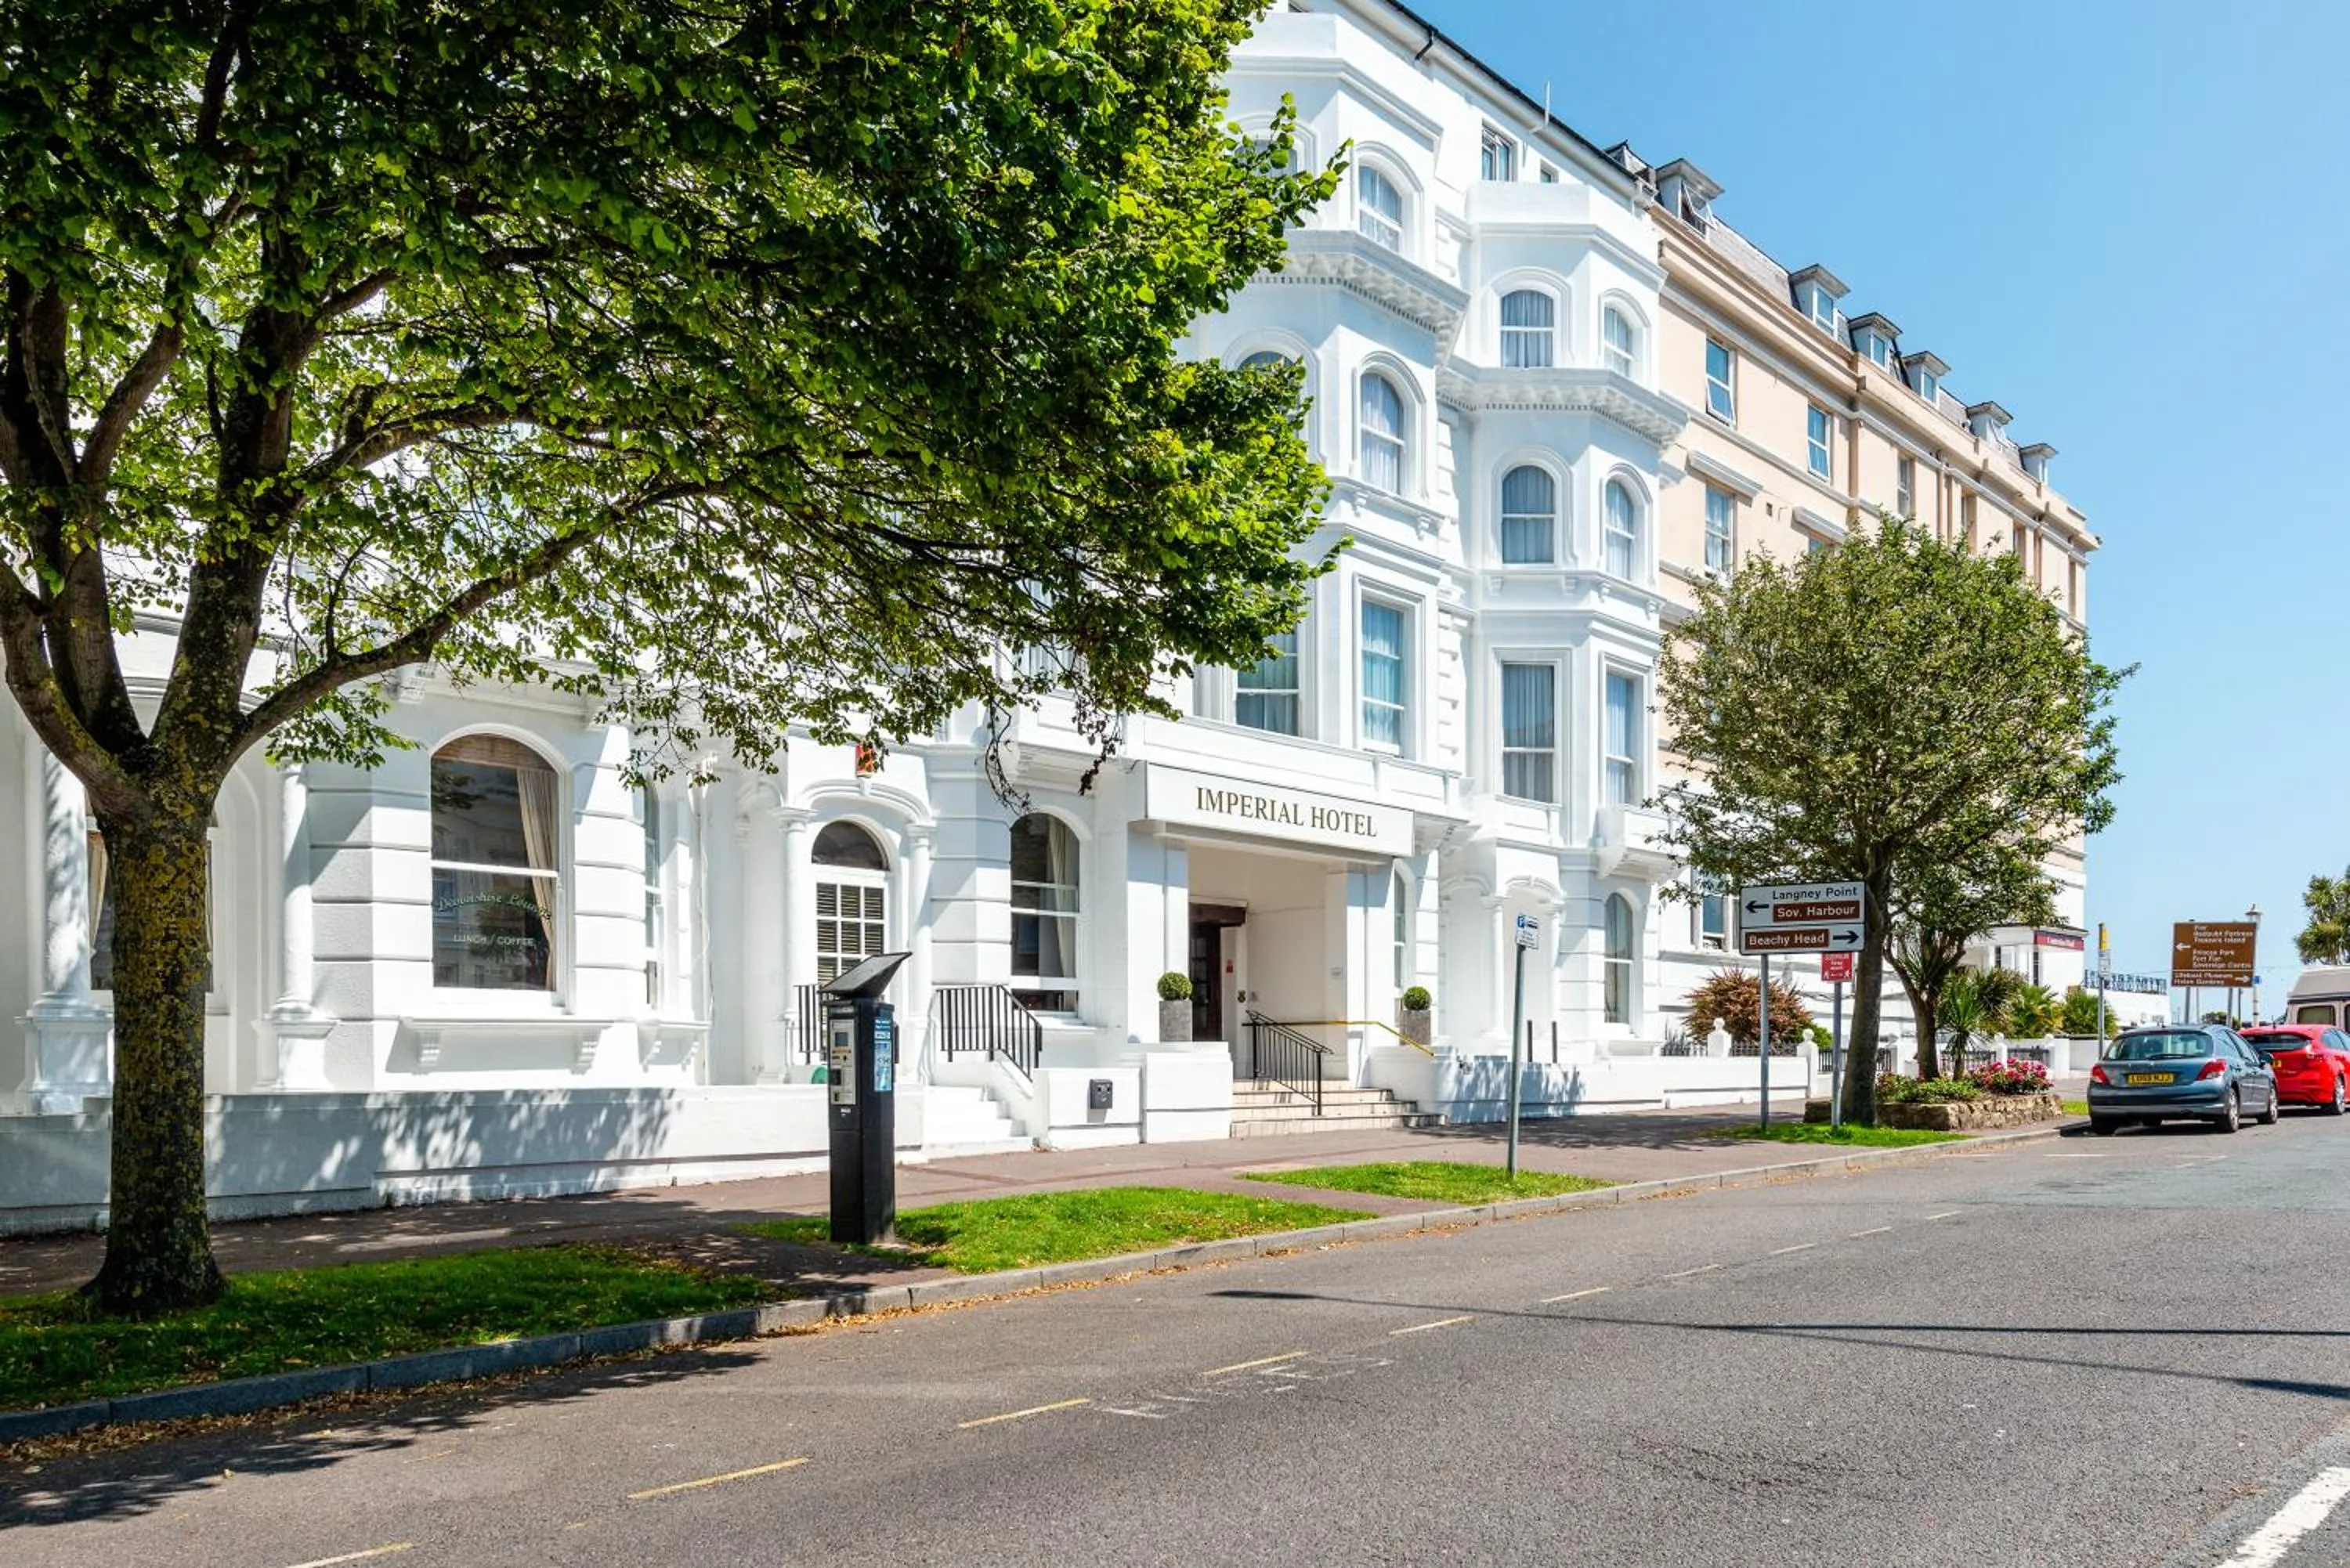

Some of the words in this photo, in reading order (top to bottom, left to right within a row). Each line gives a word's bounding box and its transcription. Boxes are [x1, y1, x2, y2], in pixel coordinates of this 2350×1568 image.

[1196, 786, 1304, 826] IMPERIAL
[1311, 806, 1377, 837] HOTEL
[1773, 889, 1821, 901] Langney
[1826, 886, 1858, 898] Point
[439, 891, 502, 912] Devonshire
[1777, 907, 1802, 918] Sov.
[1807, 905, 1856, 916] Harbour
[454, 934, 486, 944] LUNCH
[497, 936, 534, 945] COFFEE
[1749, 934, 1790, 947] Beachy
[1794, 932, 1824, 945] Head
